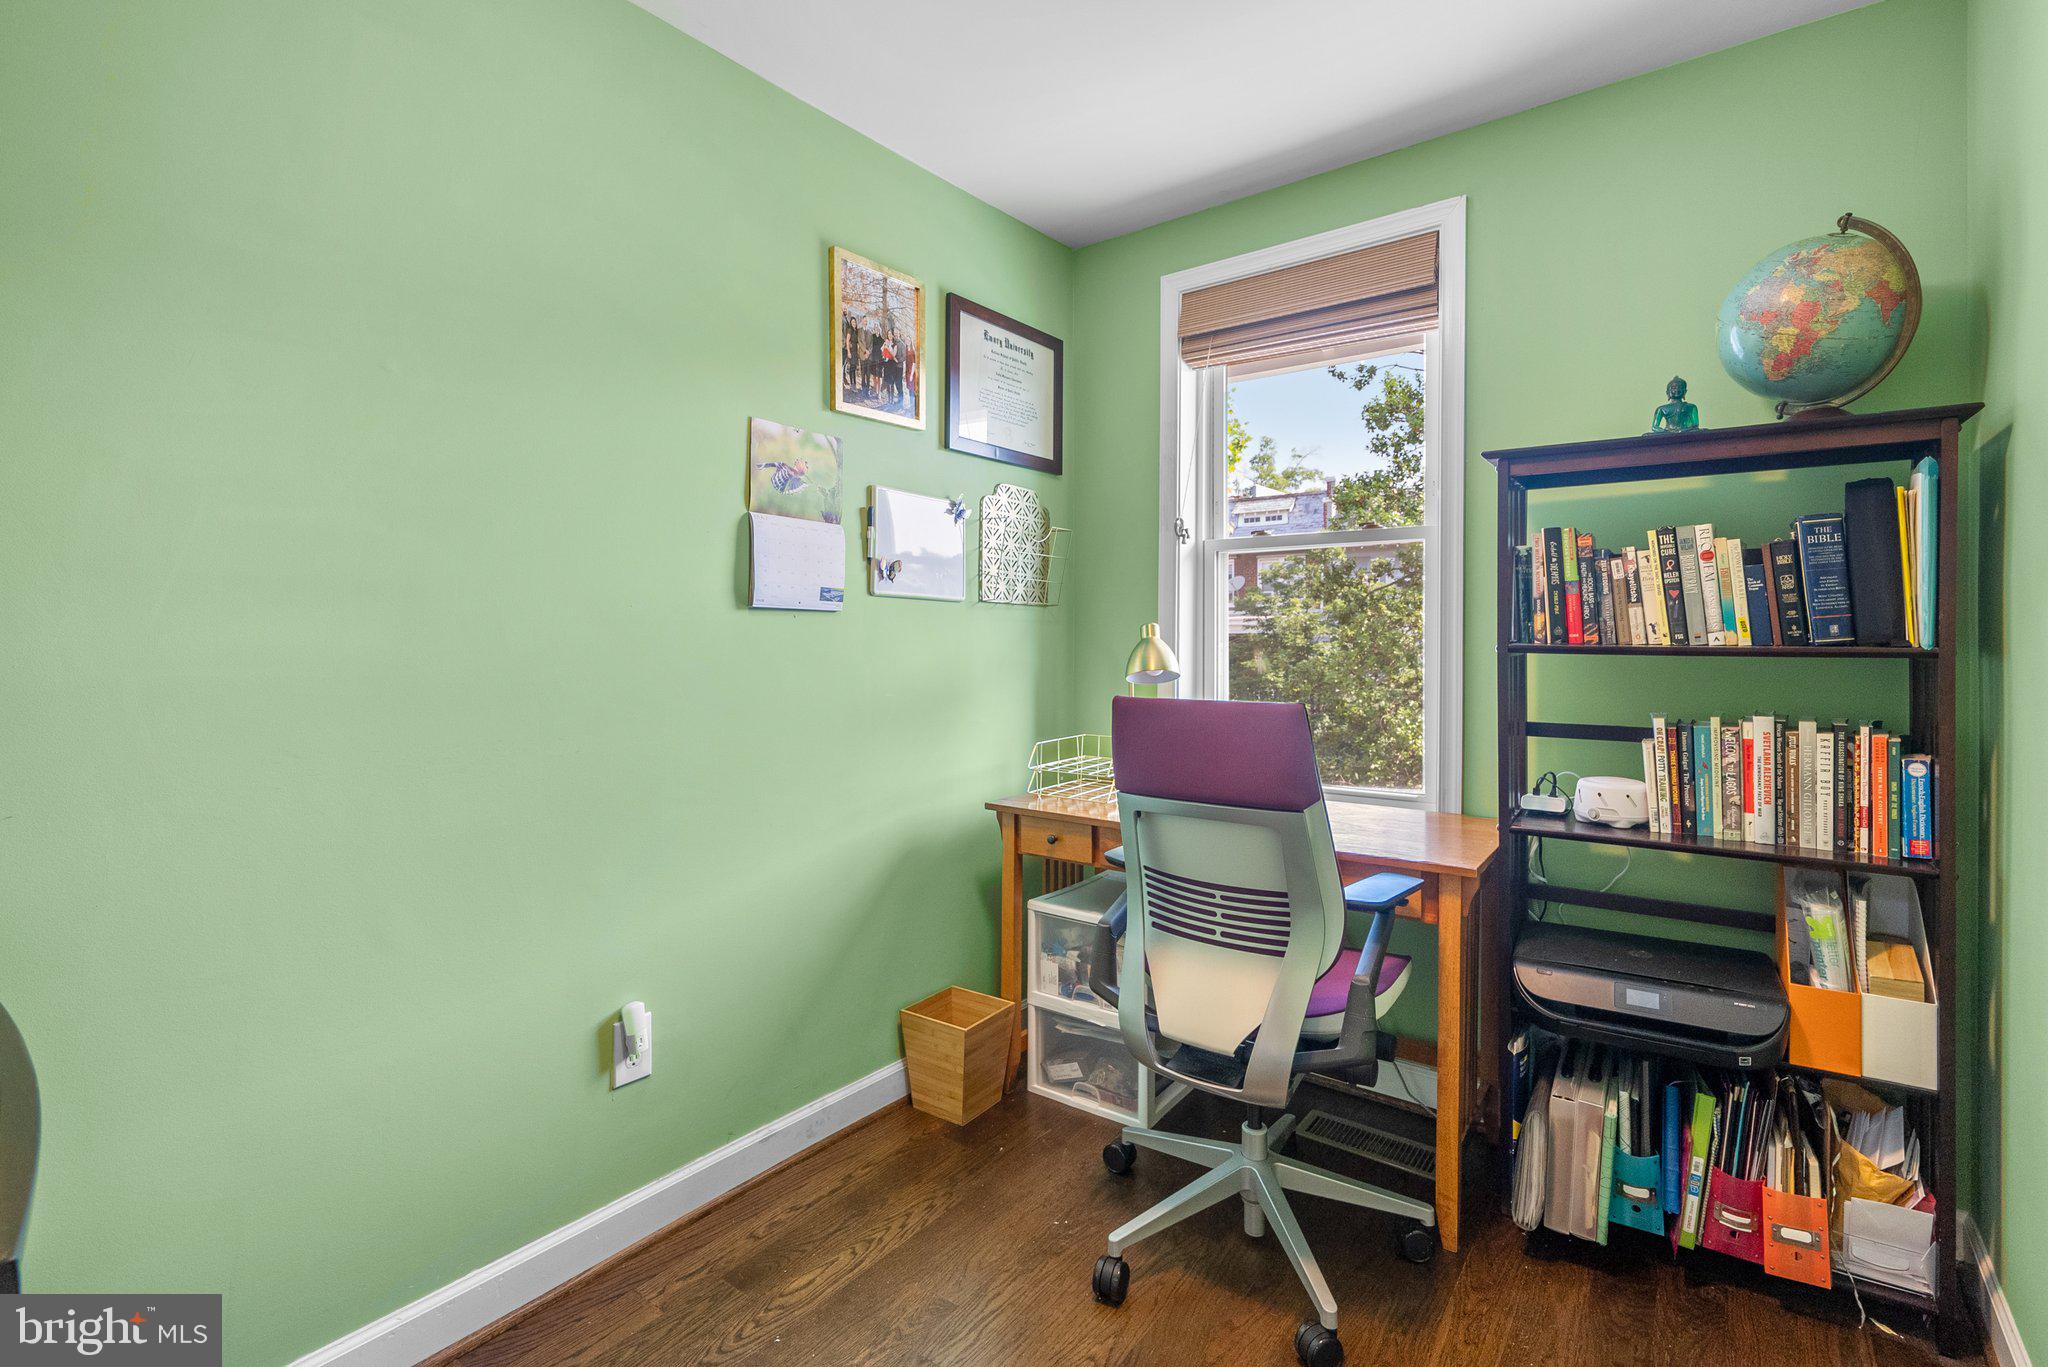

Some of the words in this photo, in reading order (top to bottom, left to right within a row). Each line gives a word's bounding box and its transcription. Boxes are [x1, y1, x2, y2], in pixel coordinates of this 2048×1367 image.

[984, 330, 1003, 348] Emory
[1004, 337, 1034, 360] University
[1659, 534, 1675, 545] THE
[1807, 533, 1842, 544] BIBLE
[1660, 548, 1676, 557] CURE
[1698, 527, 1715, 582] REQUIEM
[1734, 550, 1742, 573] POWER
[1601, 571, 1609, 594] WEDDING
[1740, 620, 1748, 633] USED
[1656, 736, 1664, 753] CRAP!
[1724, 730, 1735, 763] WELCOME
[1762, 731, 1770, 764] SVETLANA
[1820, 738, 1830, 772] KAFFIR
[1657, 755, 1665, 771] POTTY
[1681, 752, 1689, 770] Galgut
[1803, 745, 1811, 790] HERMANN
[1658, 774, 1667, 801] TRAINING
[1683, 784, 1691, 806] Promise
[1725, 772, 1736, 795] LAGOS
[1763, 766, 1771, 805] ALEXIEVICH
[1820, 779, 1830, 796] BOY
